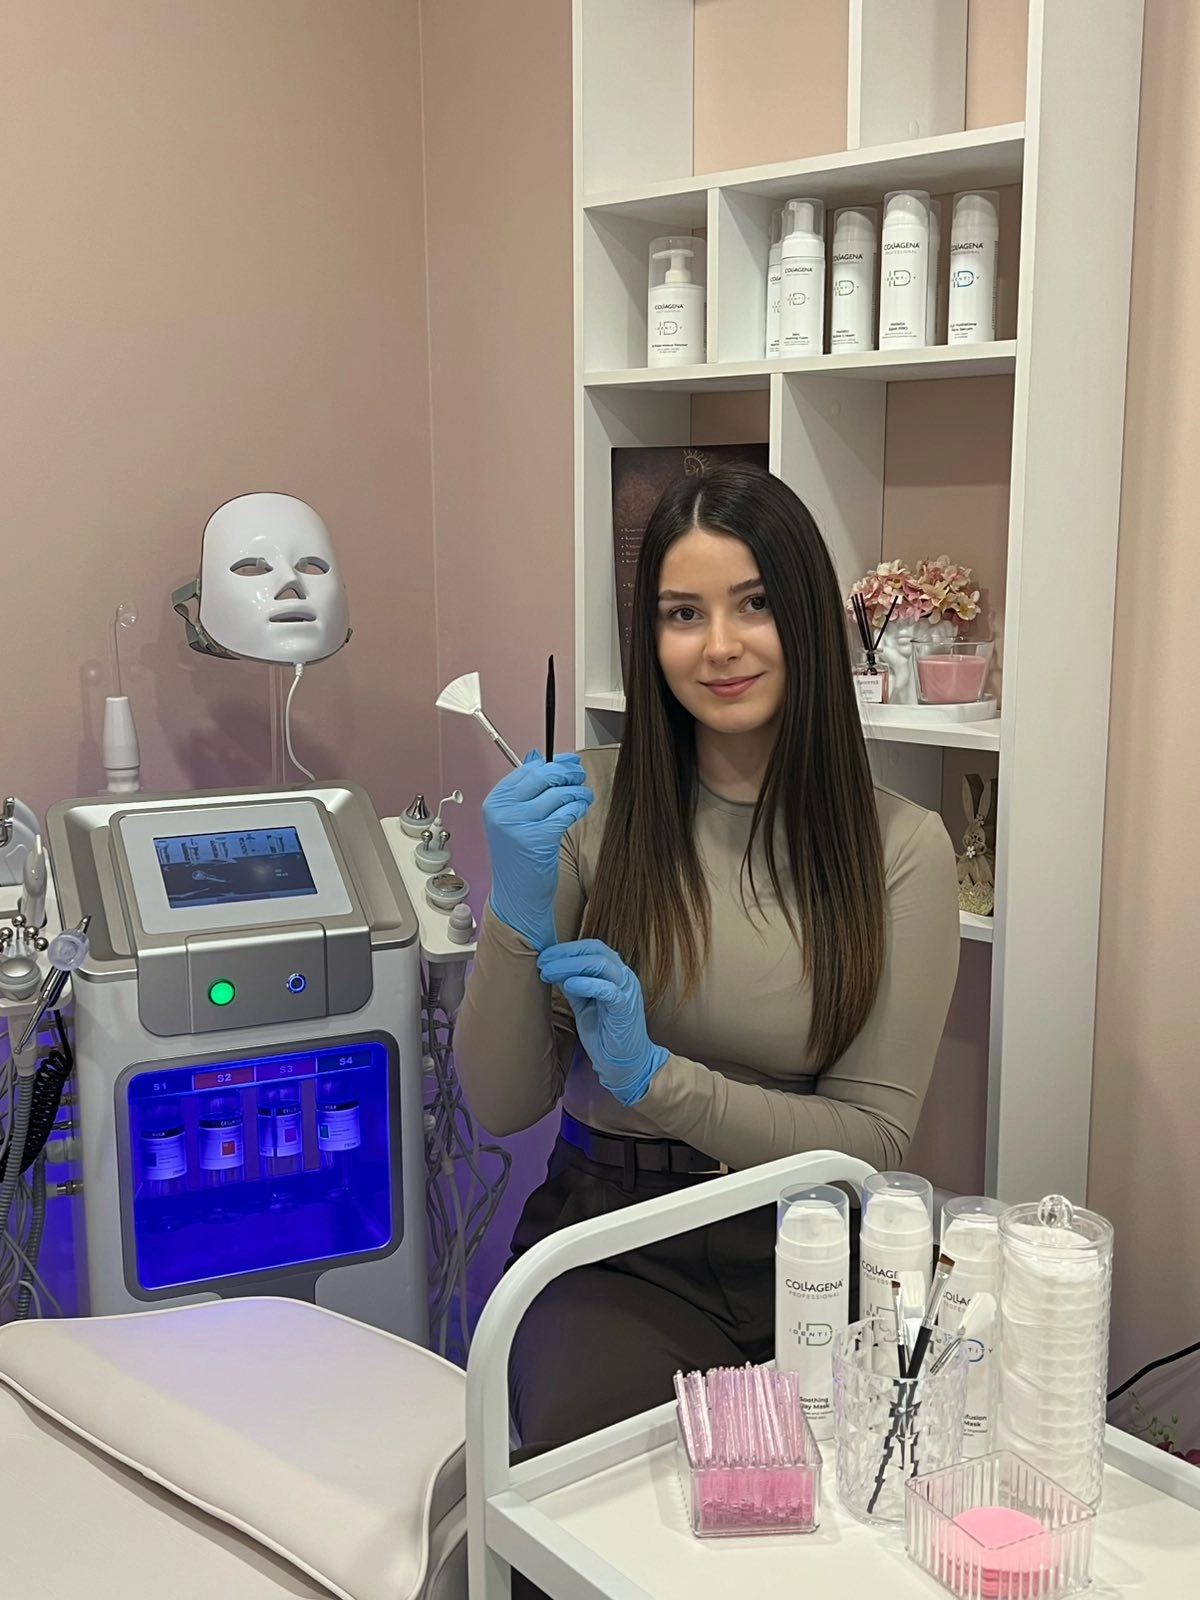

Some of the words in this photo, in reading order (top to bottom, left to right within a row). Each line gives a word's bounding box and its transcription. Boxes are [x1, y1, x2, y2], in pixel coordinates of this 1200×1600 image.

[339, 1056, 353, 1066] S4
[280, 1065, 293, 1074] S3
[217, 1073, 232, 1083] S2
[153, 1082, 167, 1091] S1
[862, 1260, 899, 1279] COLLAGE
[785, 1278, 844, 1293] COLLAGENA
[788, 1290, 840, 1300] PROFESSIONAL
[944, 1291, 971, 1305] OLLAG
